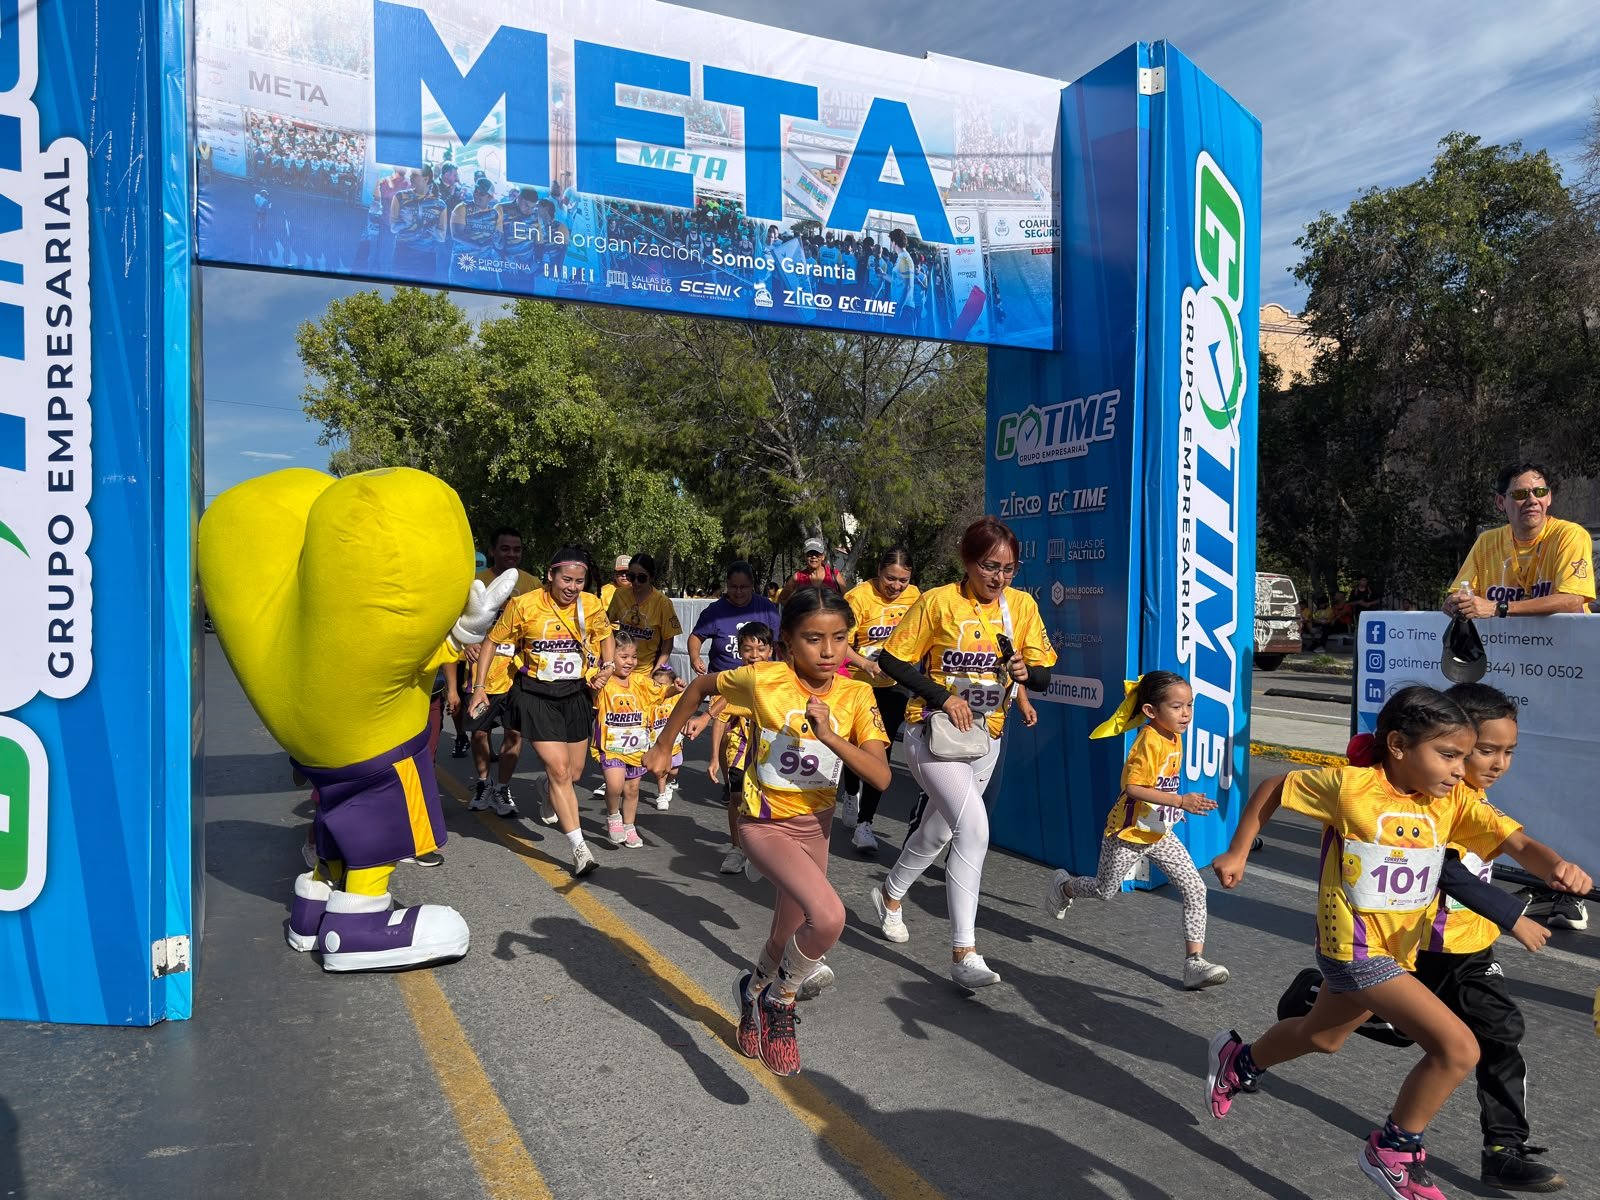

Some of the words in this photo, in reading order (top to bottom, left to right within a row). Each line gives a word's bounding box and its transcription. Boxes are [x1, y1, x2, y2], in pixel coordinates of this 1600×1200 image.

[248, 70, 329, 107] META
[374, 0, 956, 245] META
[638, 145, 728, 181] META
[513, 221, 540, 242] En
[548, 225, 565, 245] la
[572, 231, 705, 265] organización,
[711, 248, 776, 271] Somos
[781, 257, 856, 281] Garantía
[478, 258, 531, 272] PIROTECNIA
[543, 263, 595, 283] CARPEX
[631, 274, 659, 285] VALLAS
[660, 278, 672, 286] DE
[631, 282, 673, 294] SALTILLO
[863, 299, 898, 315] TIME
[44, 157, 73, 492] EMPRESARIAL
[1184, 300, 1195, 413] GRUPO
[1020, 452, 1041, 463] GRUPO
[1042, 445, 1087, 459] EMPRESARIAL
[1072, 486, 1108, 509] TIME
[1068, 540, 1093, 550] VALLAS
[1094, 539, 1105, 549] DE
[1181, 426, 1192, 651] EMPRESARIAL
[1068, 549, 1105, 560] SALTILLO
[47, 514, 75, 679] GRUPO
[1078, 587, 1104, 595] BODEGAS
[1388, 628, 1405, 640] Go
[1406, 628, 1437, 641] Time
[553, 660, 575, 675] 50
[1520, 663, 1543, 677] 160
[1547, 664, 1584, 680] 0502
[959, 688, 1000, 707] 135
[620, 735, 639, 747] 70
[779, 751, 820, 777] 99
[1370, 864, 1431, 895] 101
